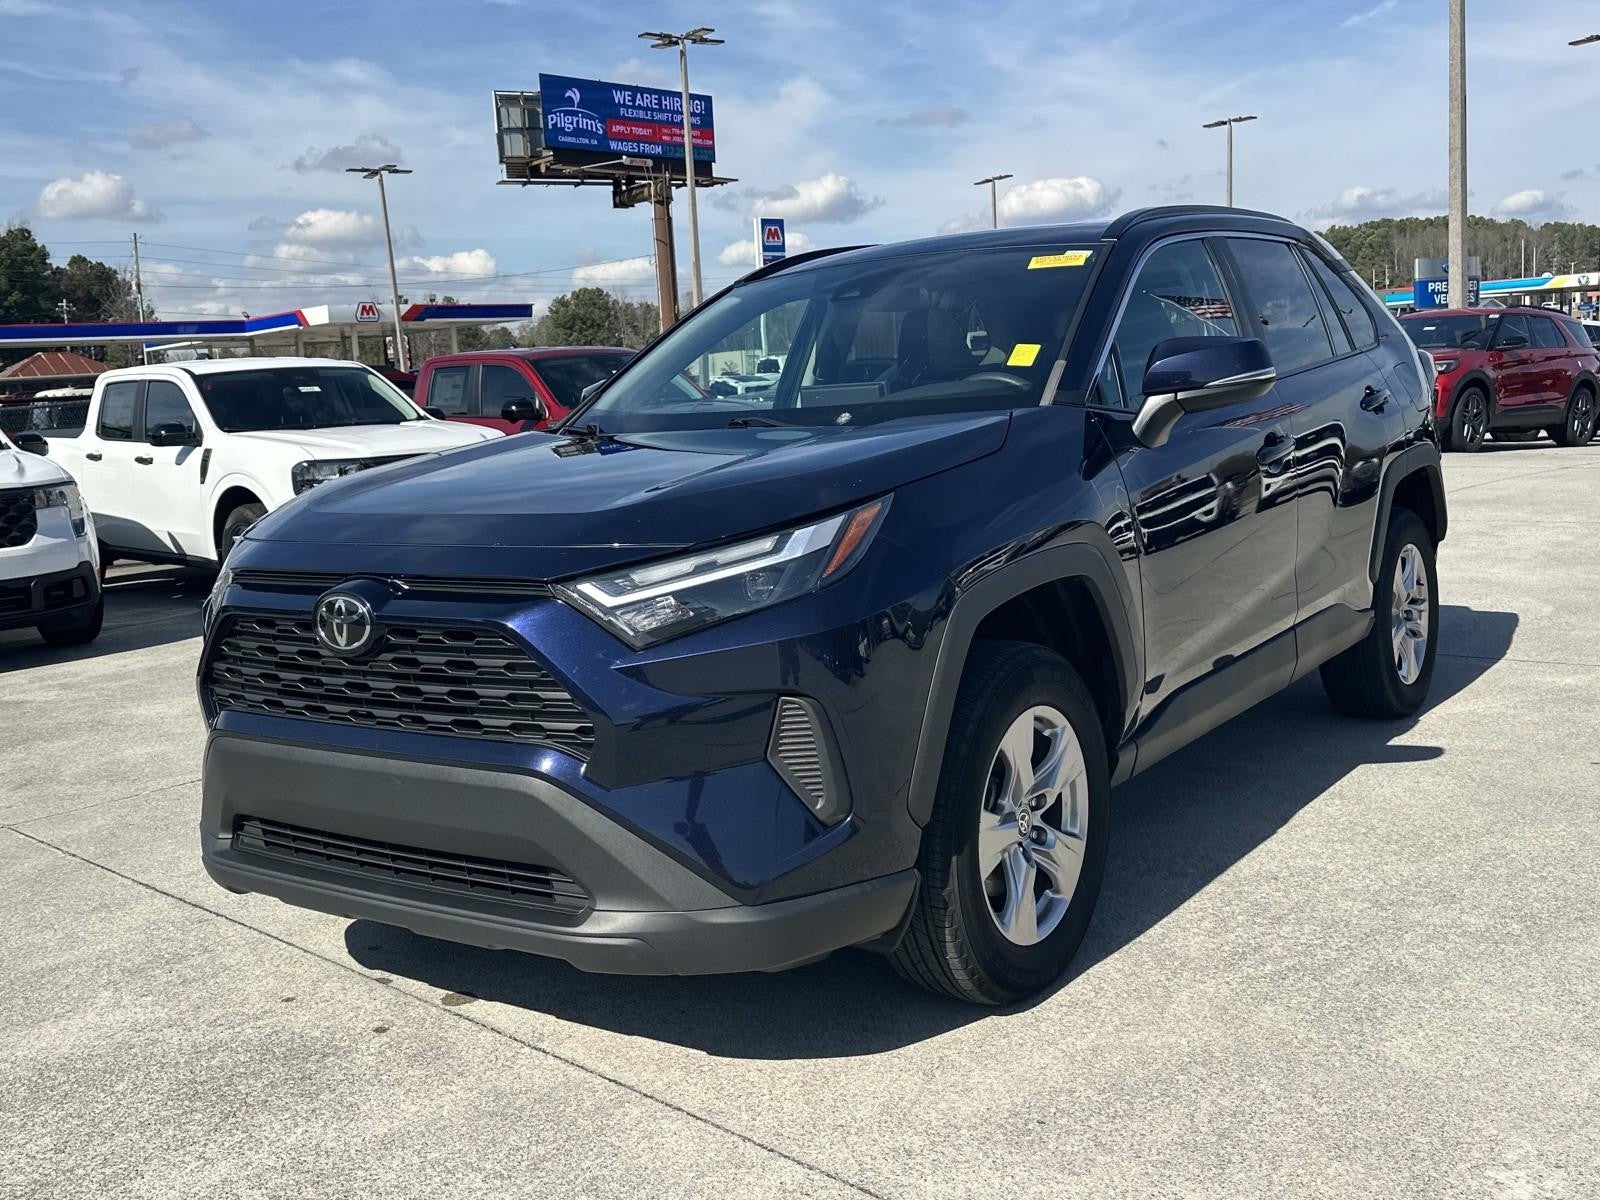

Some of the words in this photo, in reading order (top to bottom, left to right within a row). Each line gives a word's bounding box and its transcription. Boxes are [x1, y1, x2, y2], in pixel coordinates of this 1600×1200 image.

[612, 89, 632, 105] WE
[635, 92, 659, 108] ARE
[661, 96, 705, 114] HIRNG!
[620, 108, 652, 120] FLEXIBLE
[653, 112, 672, 122] SHIFT
[547, 112, 604, 135] Pilgrim's
[612, 125, 631, 134] APPLY
[609, 140, 638, 152] WAGES
[640, 143, 663, 155] FROM
[1428, 280, 1478, 293] PREED
